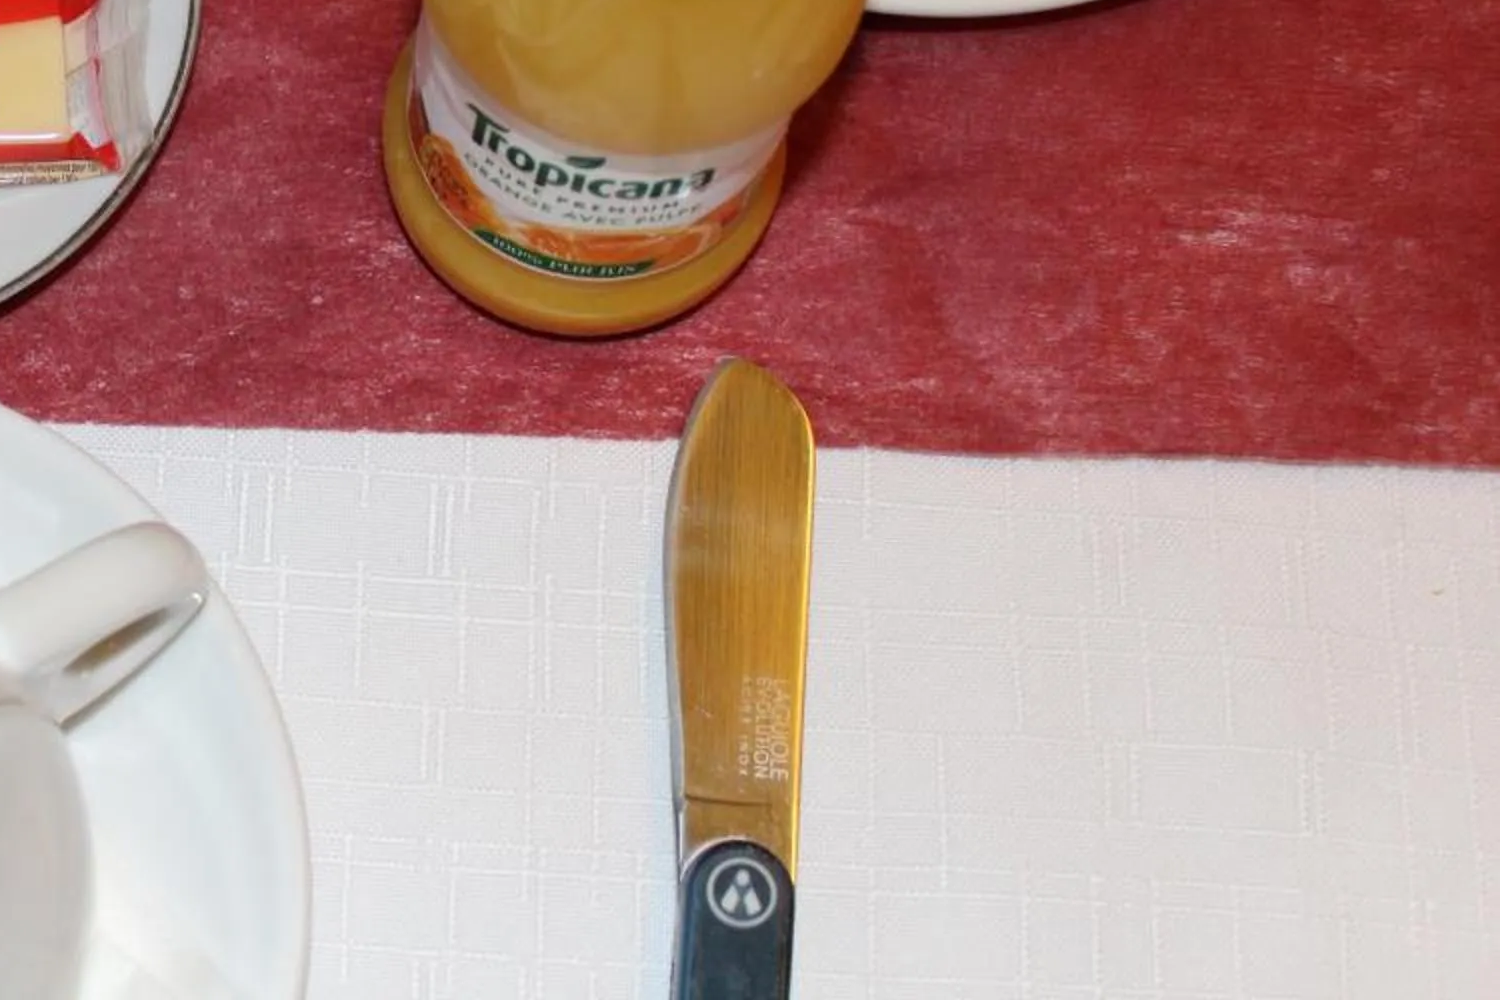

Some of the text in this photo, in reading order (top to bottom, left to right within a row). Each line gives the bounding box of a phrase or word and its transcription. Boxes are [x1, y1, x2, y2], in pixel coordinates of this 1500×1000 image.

[463, 151, 707, 226] ORANGE AVEC PULPE
[467, 102, 717, 200] Tropicana
[484, 156, 681, 215] PURE PREMIUM
[753, 676, 772, 778] EVOLUTION
